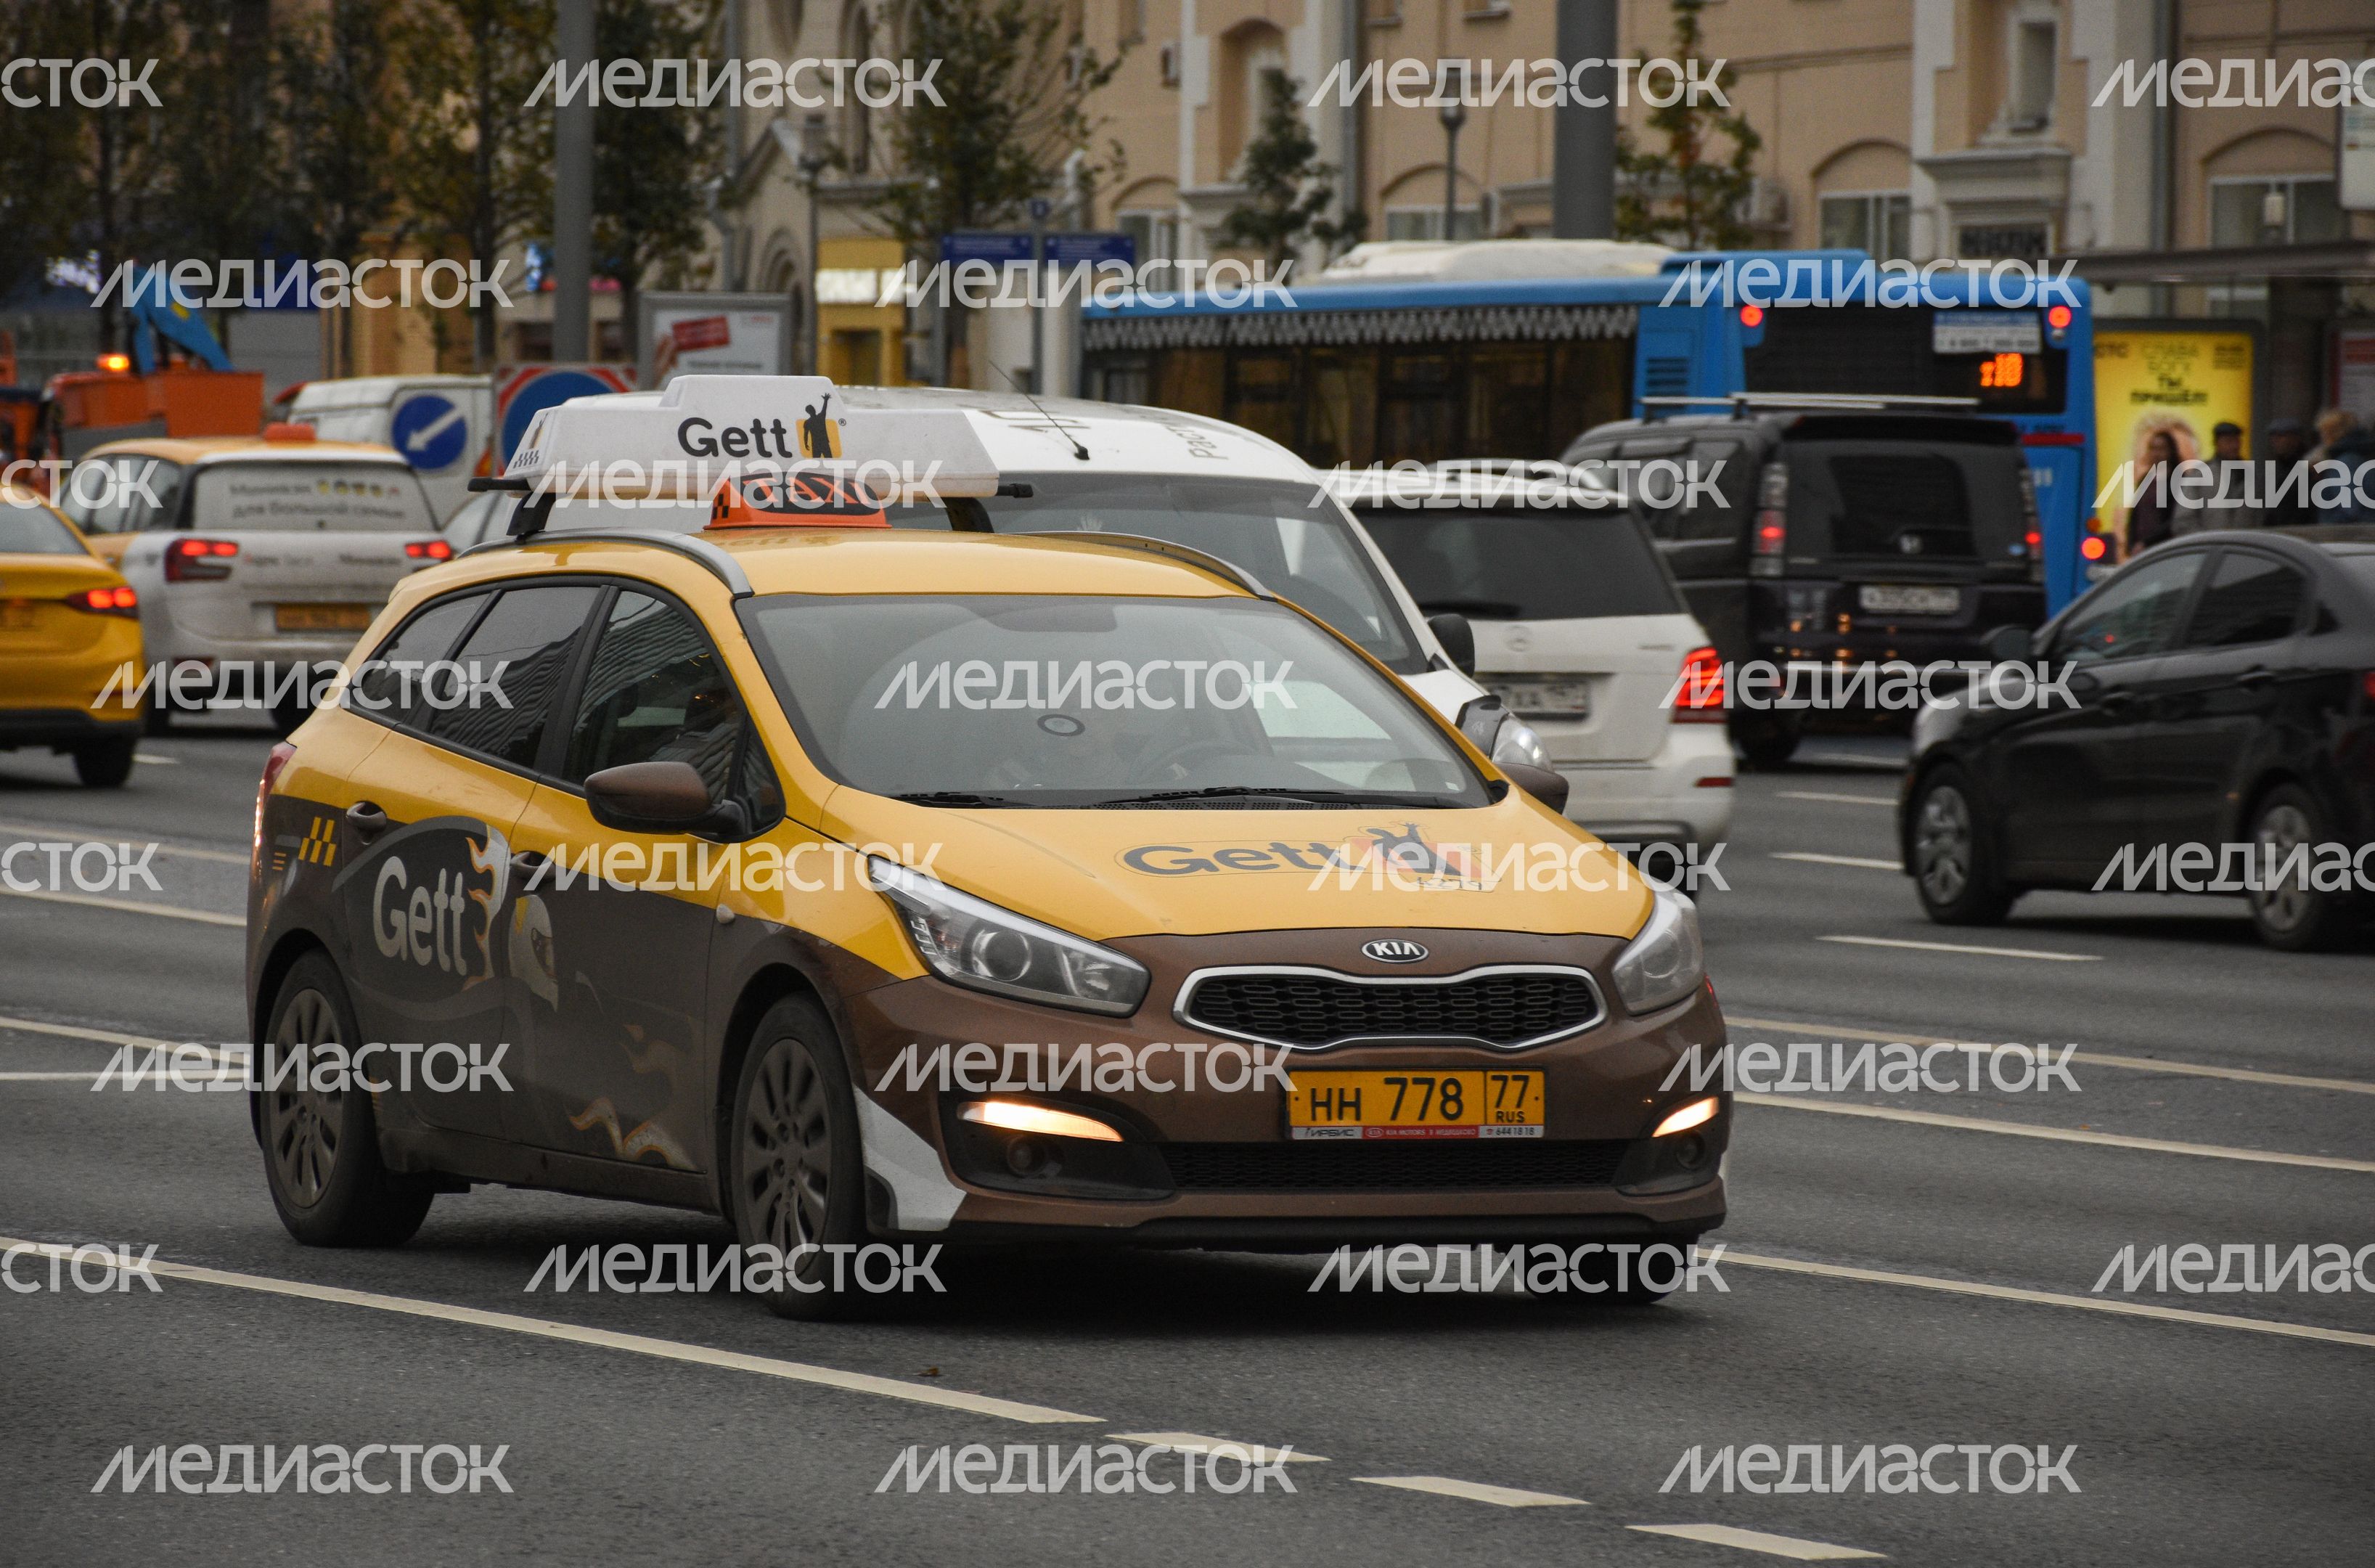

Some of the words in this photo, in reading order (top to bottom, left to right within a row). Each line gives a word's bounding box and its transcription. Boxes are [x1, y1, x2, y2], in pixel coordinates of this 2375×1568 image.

[678, 417, 793, 458] Gett
[743, 476, 871, 505] TAXI
[1124, 841, 1366, 875] Gett
[373, 856, 467, 976] Gett
[1371, 942, 1421, 956] KIA
[1384, 1077, 1463, 1120] 778
[1491, 1074, 1530, 1108] 77
[1495, 1111, 1525, 1123] RUS
[1496, 1127, 1511, 1136] 644
